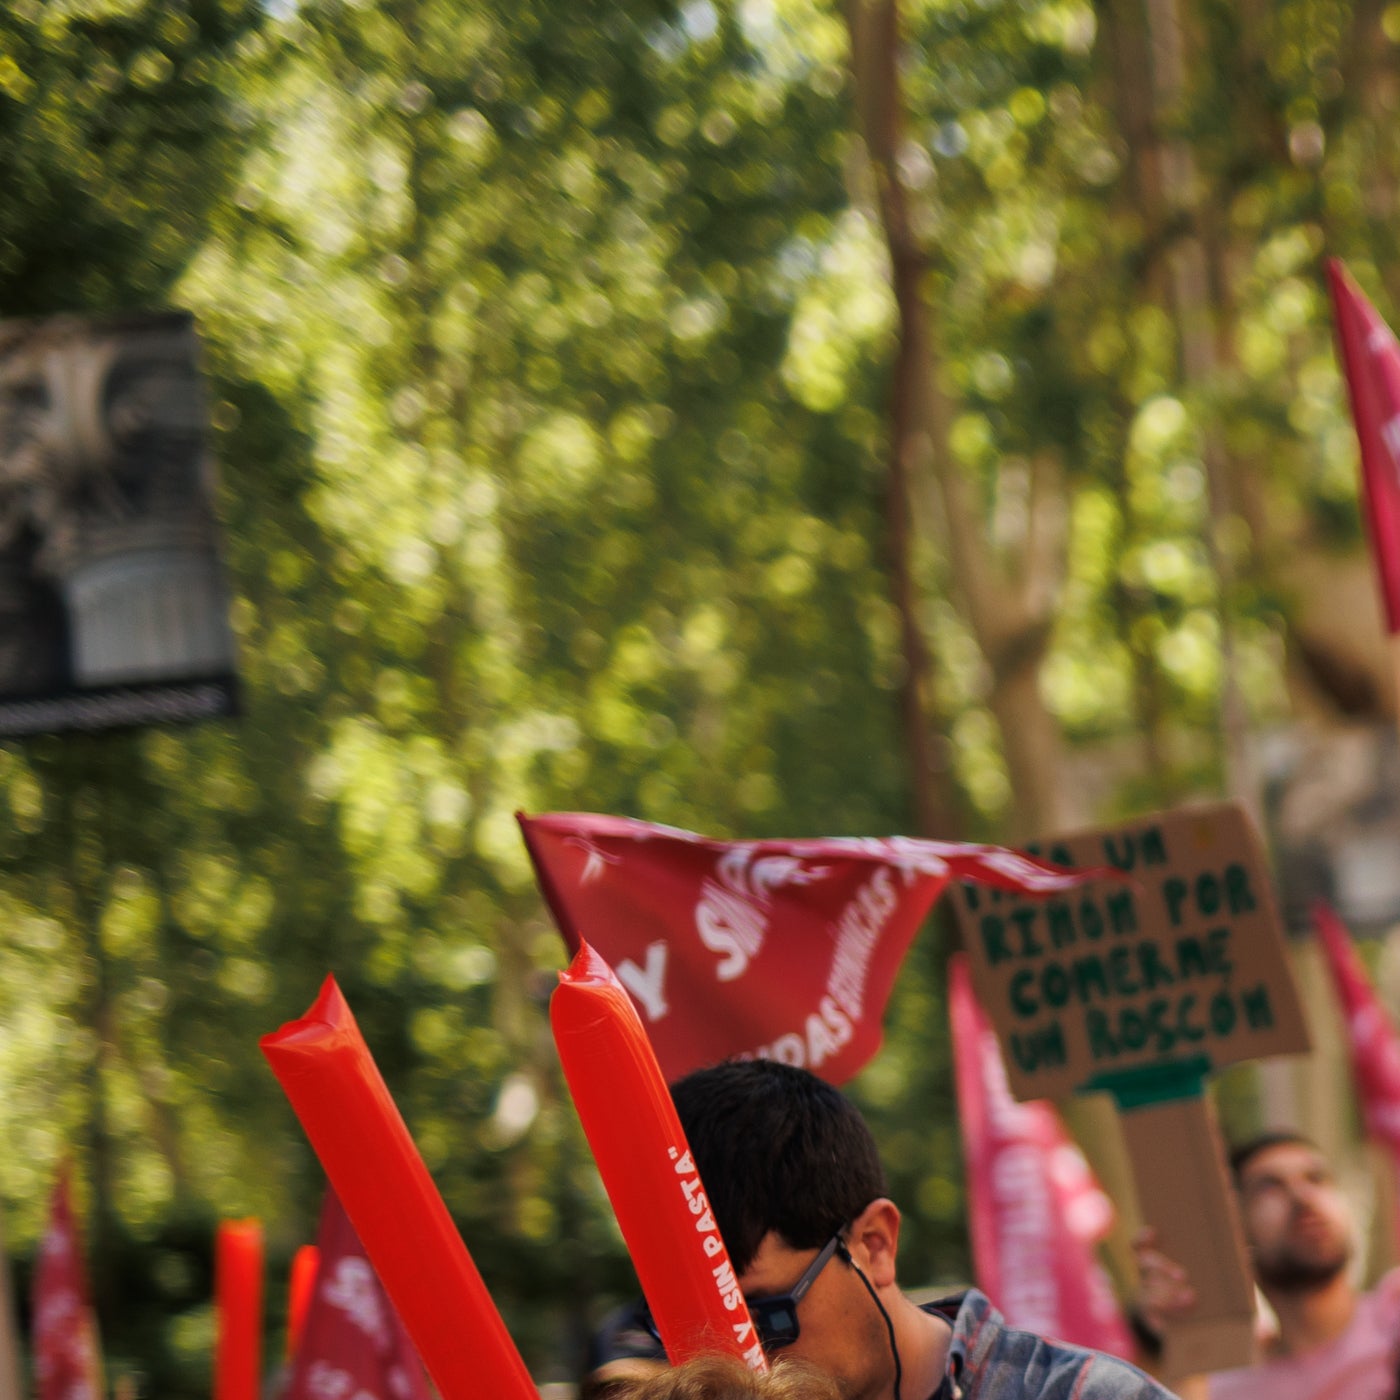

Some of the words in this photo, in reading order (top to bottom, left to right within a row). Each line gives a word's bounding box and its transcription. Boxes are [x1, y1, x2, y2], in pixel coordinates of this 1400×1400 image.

[1162, 862, 1257, 927] POR
[1009, 927, 1234, 1021] COMERME
[1008, 1020, 1068, 1076] UN
[711, 1259, 743, 1312] SIN
